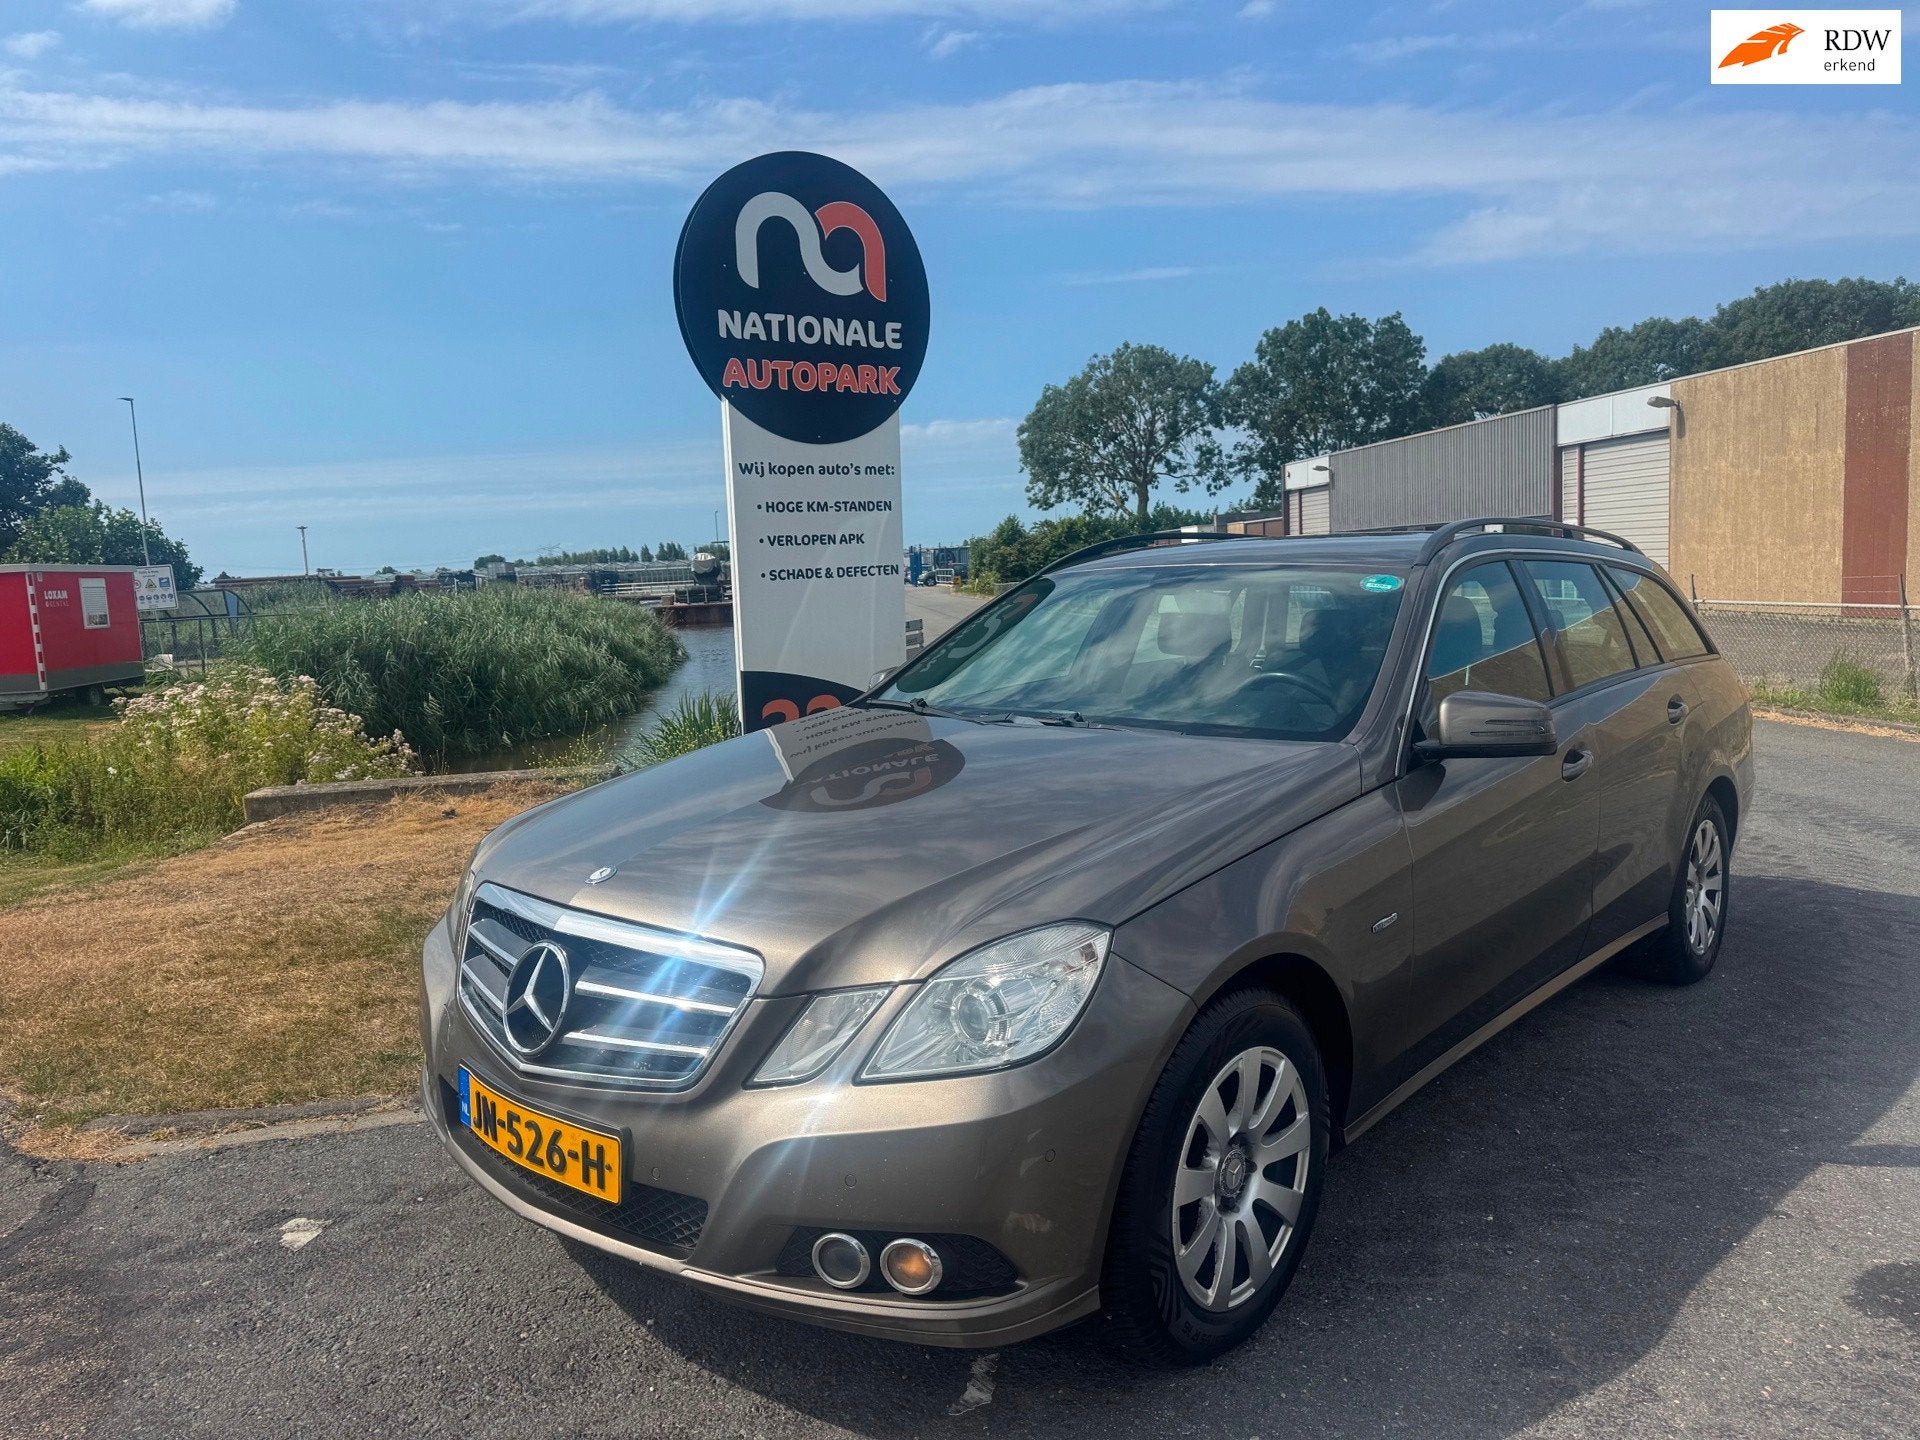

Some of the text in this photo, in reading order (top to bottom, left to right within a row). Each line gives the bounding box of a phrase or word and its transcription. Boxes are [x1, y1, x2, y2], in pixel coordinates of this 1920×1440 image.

[717, 309, 902, 349] NATIONALE
[722, 357, 901, 394] AUTOPARK
[738, 462, 895, 478] Wij kopen auto's met:
[765, 500, 892, 513] HOGE KM-STANDEN
[767, 533, 865, 546] VERLOPEN APK
[769, 564, 899, 581] SCHADE & DEFECTEN
[44, 590, 68, 600] LOXAM
[473, 1090, 606, 1190] JN-526-H
